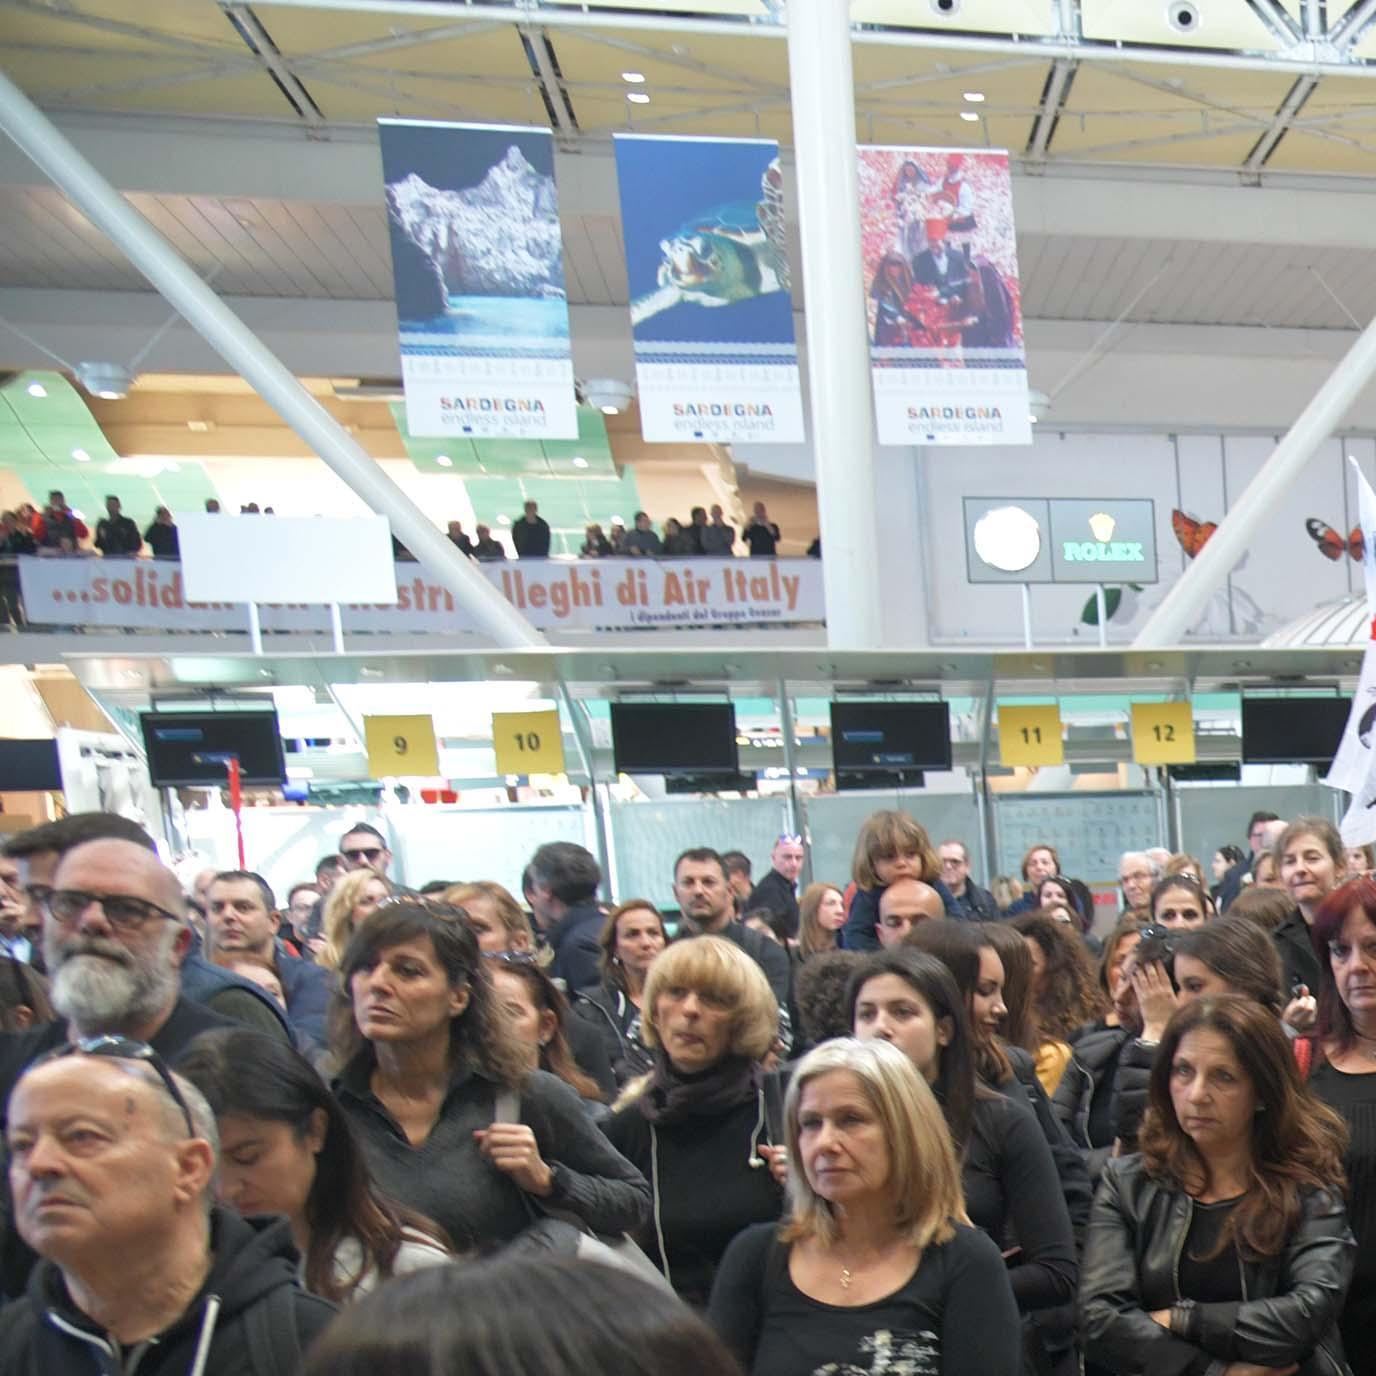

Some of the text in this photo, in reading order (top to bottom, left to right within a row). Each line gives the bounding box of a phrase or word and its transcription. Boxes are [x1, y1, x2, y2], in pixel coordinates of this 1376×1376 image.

[440, 398, 545, 411] SARDEGNA
[672, 403, 773, 416] SARDEGNA
[907, 407, 1002, 419] SARDEGNA
[1063, 542, 1145, 562] ROLEX
[617, 565, 649, 607] di
[662, 566, 713, 606] Air
[723, 562, 801, 610] Italy
[514, 732, 541, 752] 10
[1021, 727, 1042, 744] 11
[1152, 724, 1175, 742] 12
[393, 735, 408, 756] 9
